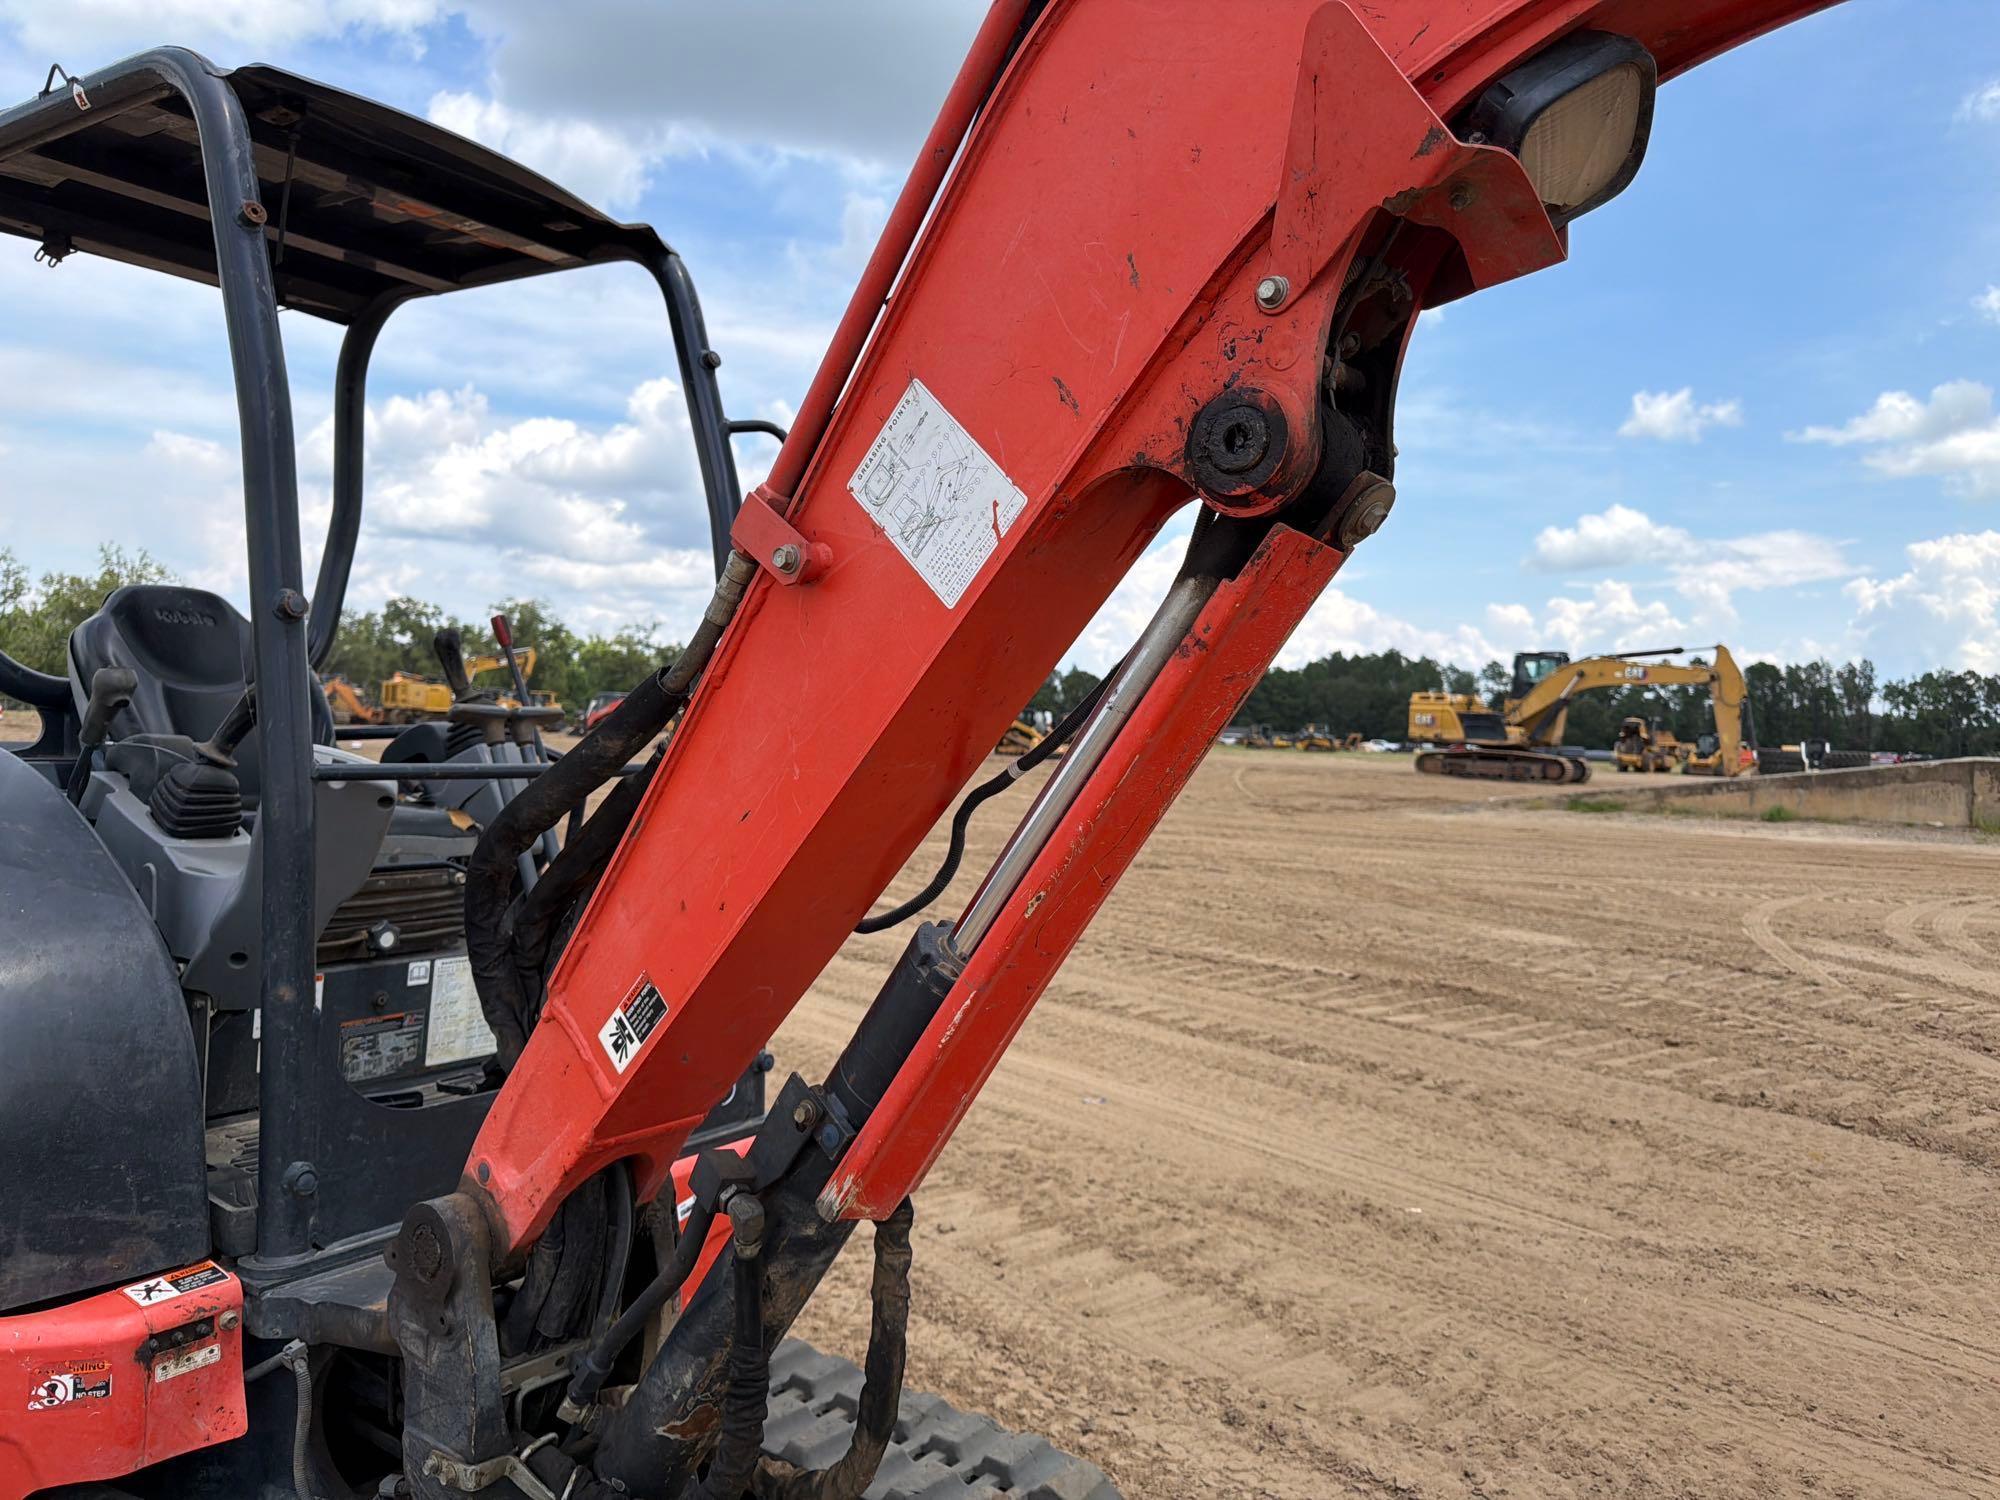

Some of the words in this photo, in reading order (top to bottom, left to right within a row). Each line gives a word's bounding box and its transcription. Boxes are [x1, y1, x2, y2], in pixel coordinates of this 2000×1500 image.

[856, 435, 887, 481] GREASING
[888, 397, 911, 432] POINTS
[155, 609, 217, 627] Kubota
[1625, 666, 1648, 681] CAT
[87, 1390, 106, 1398] STEP
